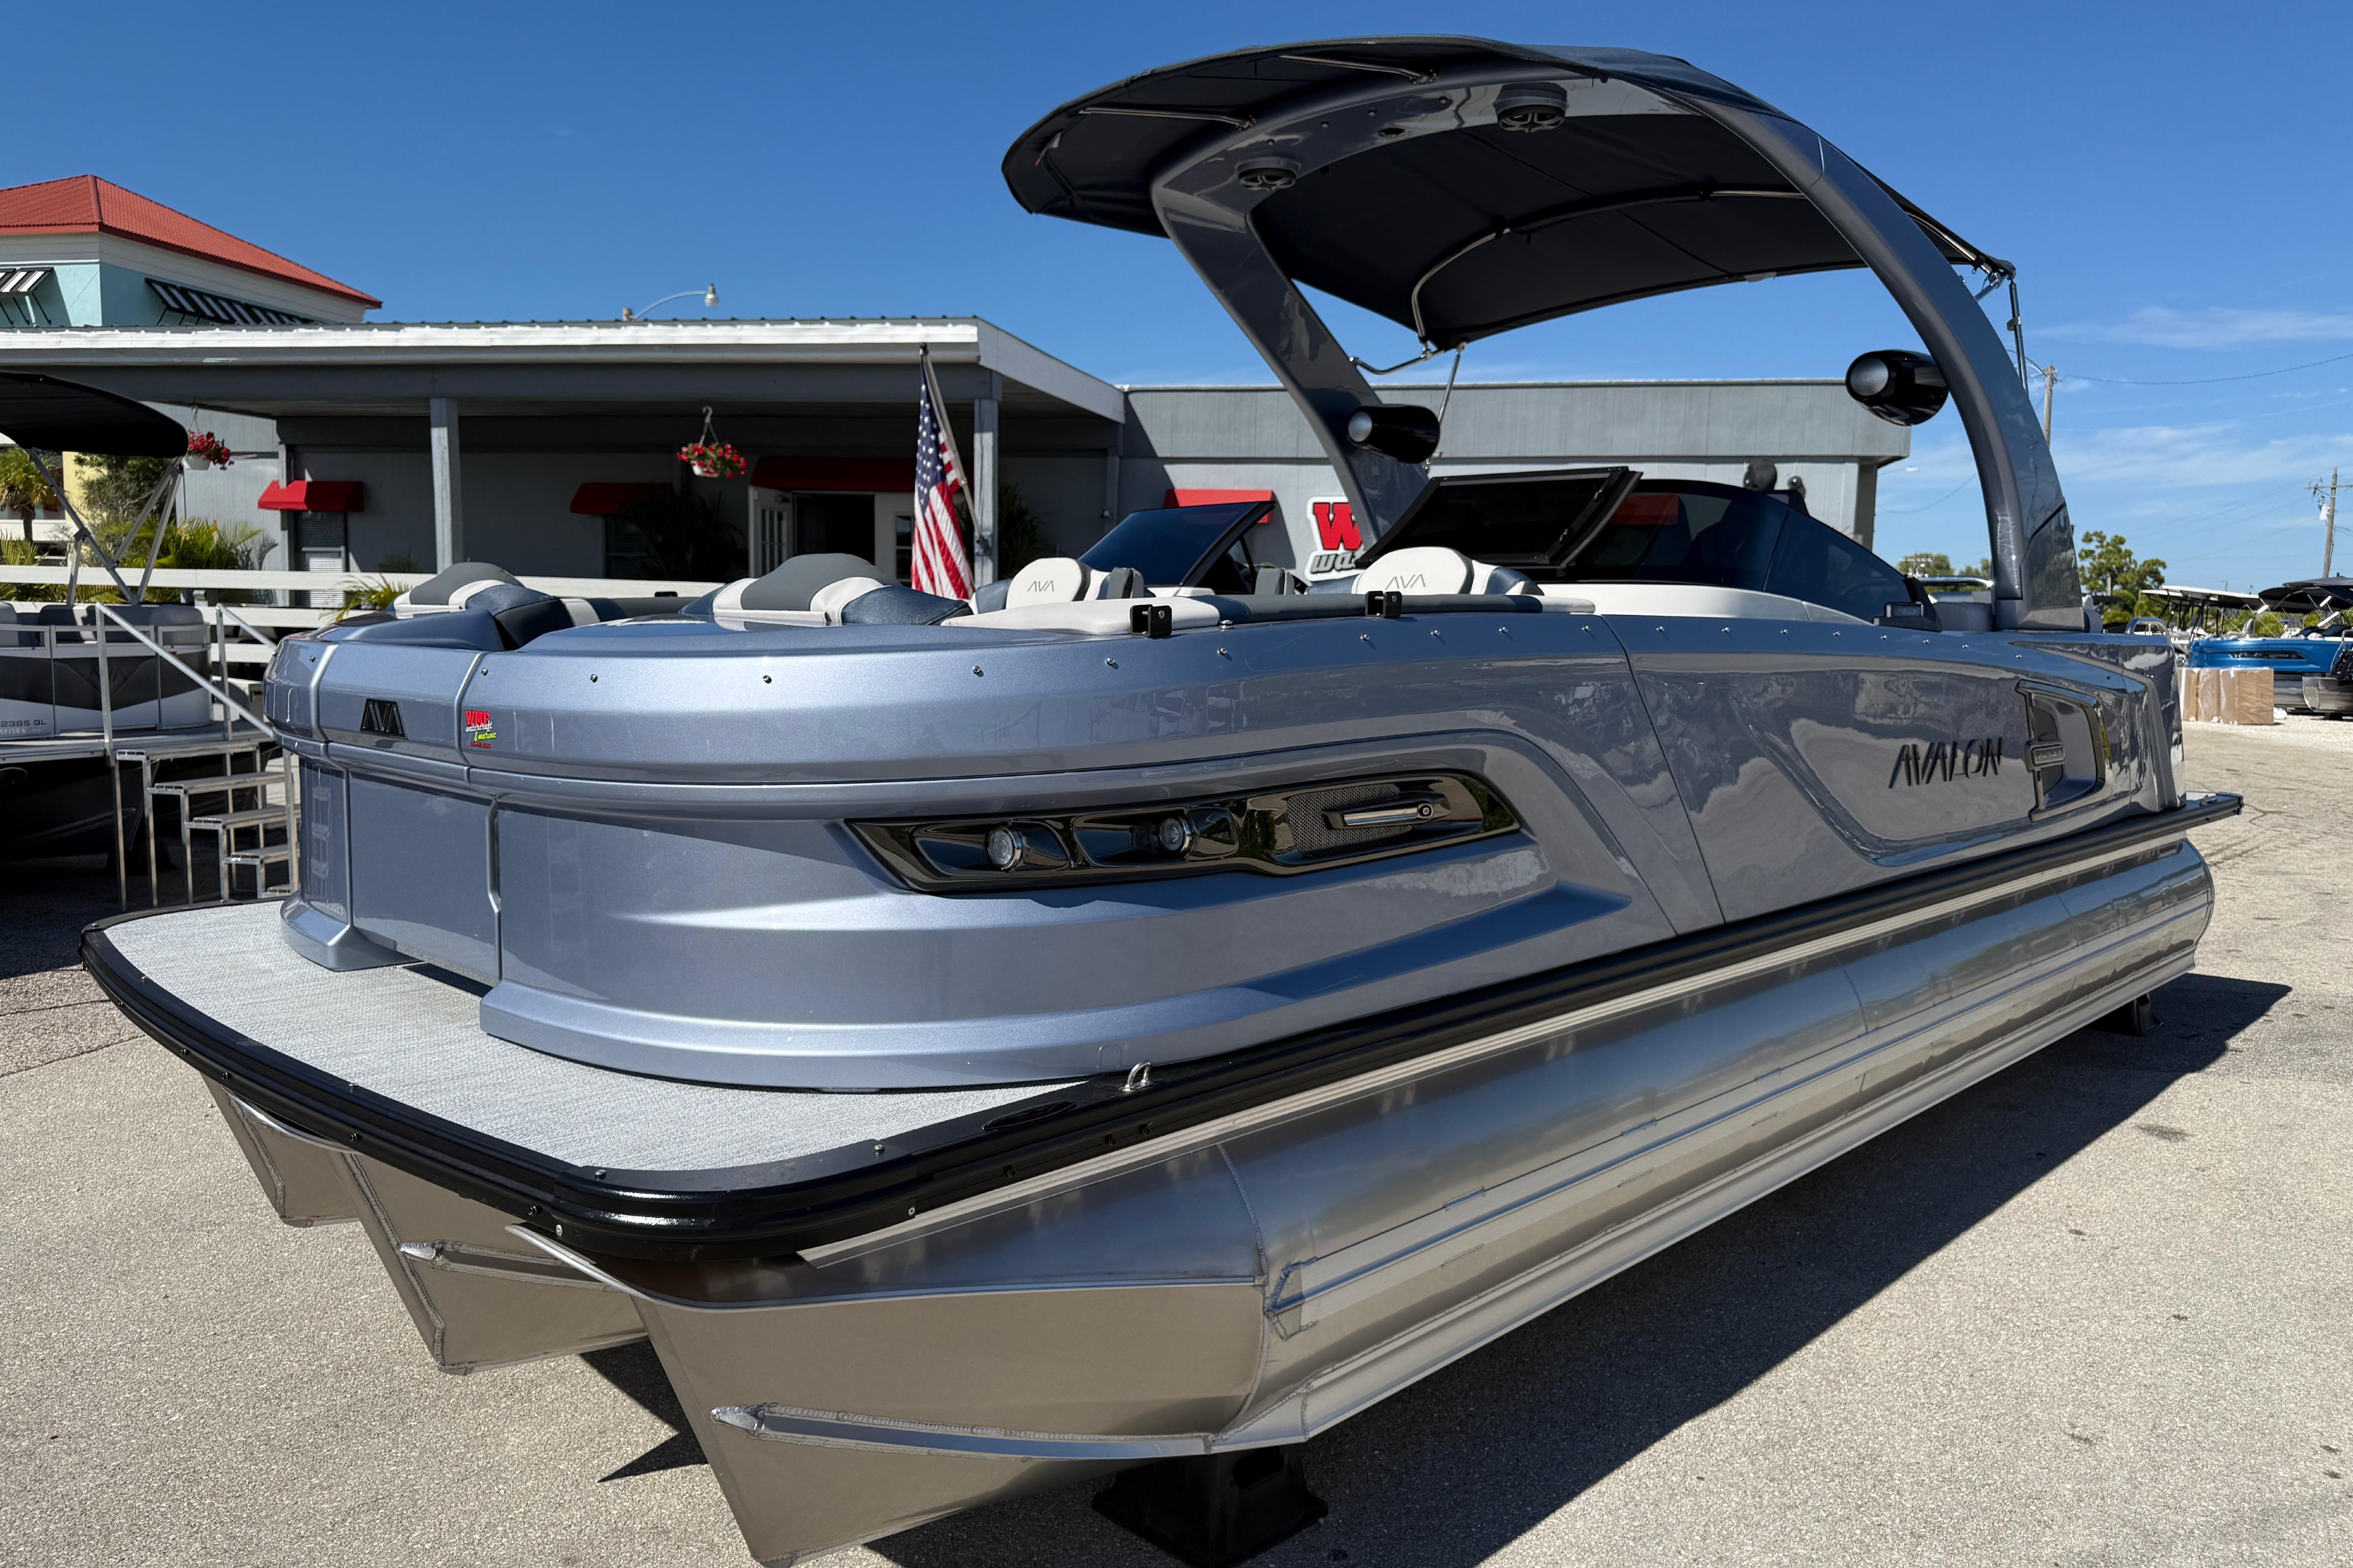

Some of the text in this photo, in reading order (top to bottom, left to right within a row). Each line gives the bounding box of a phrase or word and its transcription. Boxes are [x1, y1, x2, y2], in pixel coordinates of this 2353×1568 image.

[1313, 502, 1362, 550] W
[1027, 580, 1054, 592] AVA
[1385, 574, 1426, 590] AVA
[362, 701, 403, 734] AVA
[1889, 737, 2003, 789] AVALON
